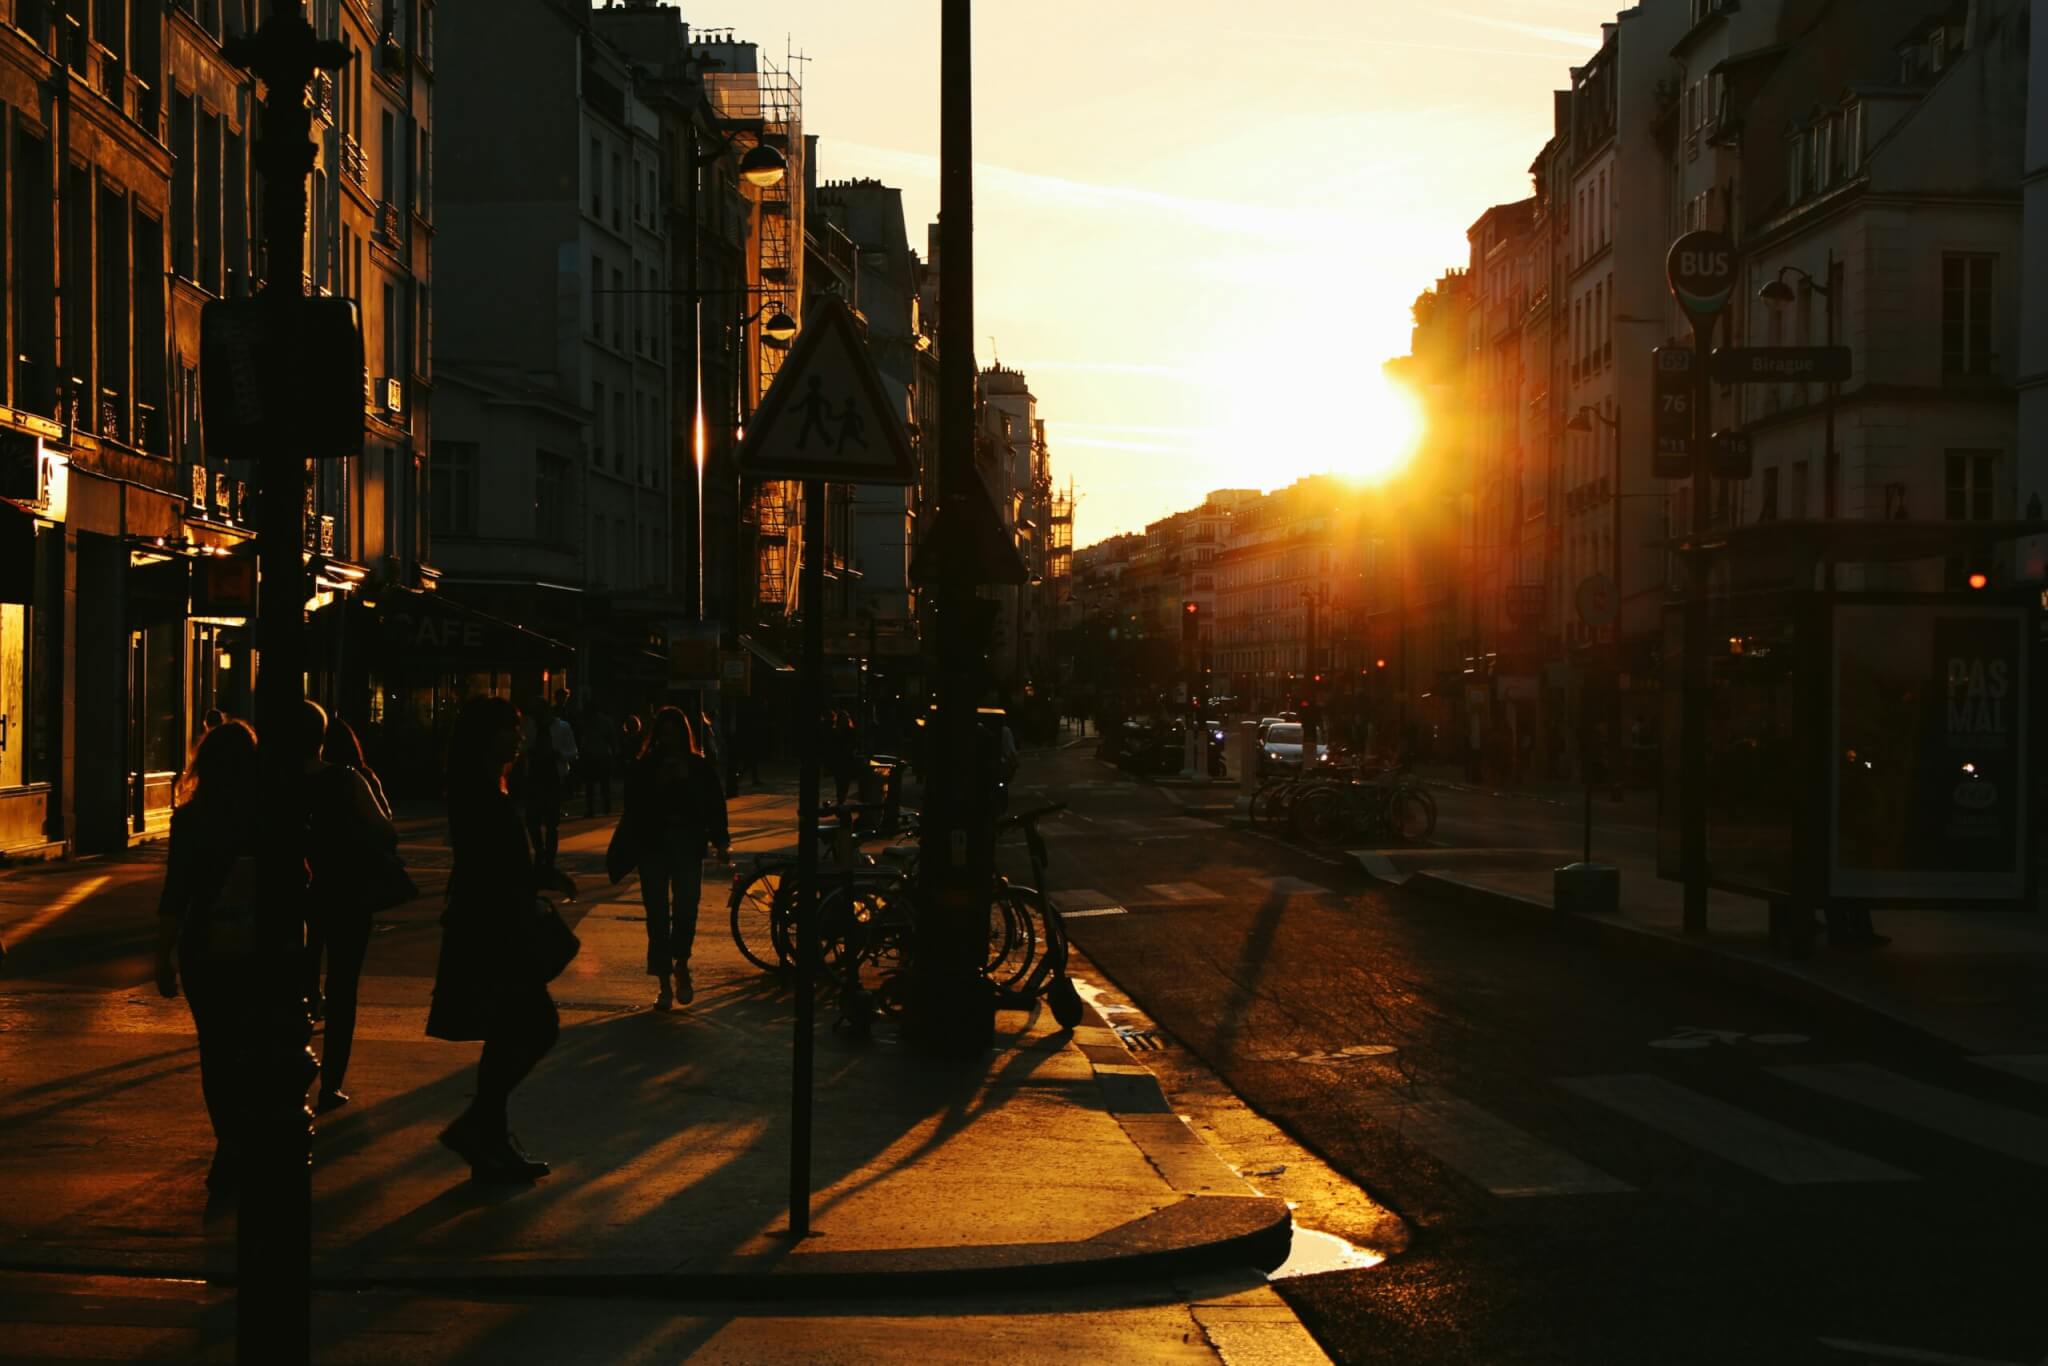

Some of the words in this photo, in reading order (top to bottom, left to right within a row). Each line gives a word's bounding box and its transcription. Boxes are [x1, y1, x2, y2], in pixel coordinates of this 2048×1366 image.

[1680, 251, 1729, 276] BUS
[1752, 356, 1815, 375] Birague
[1662, 394, 1687, 413] 76
[1947, 658, 2008, 699] PAS
[1947, 700, 2007, 733] MAL
